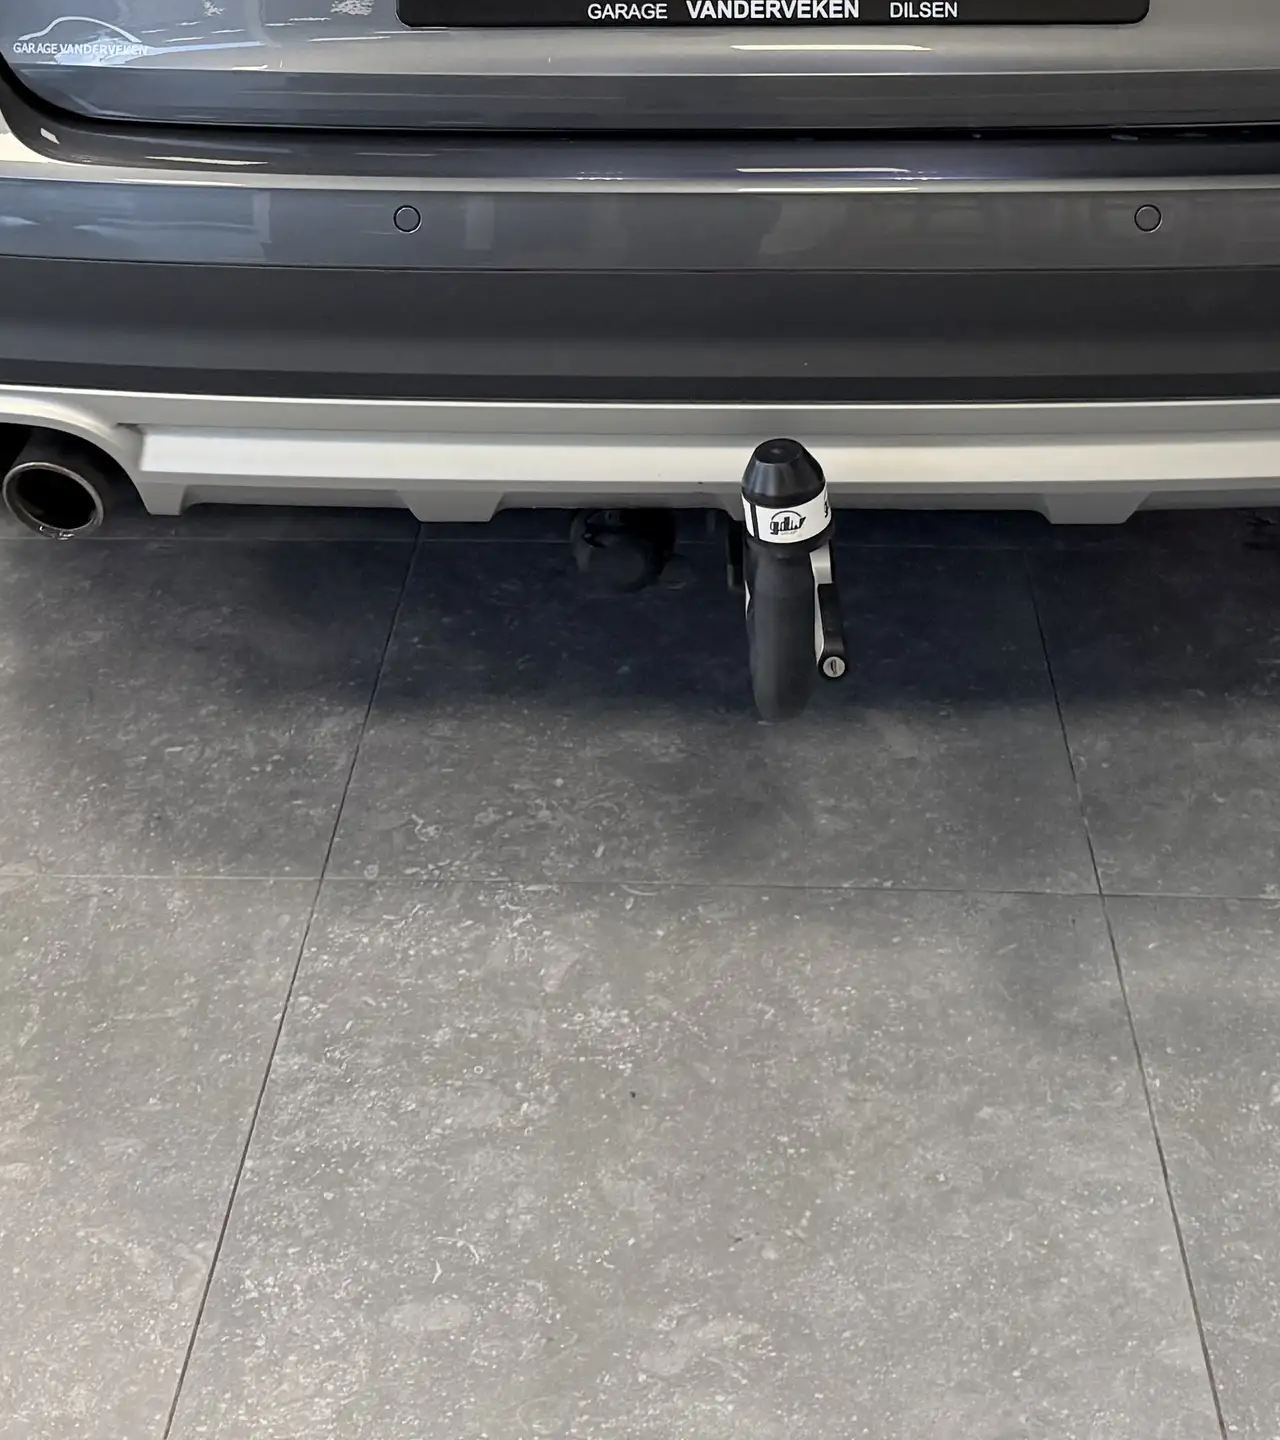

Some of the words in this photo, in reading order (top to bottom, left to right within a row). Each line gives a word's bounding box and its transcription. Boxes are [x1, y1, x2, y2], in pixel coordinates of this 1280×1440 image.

[587, 3, 668, 20] GARAGE
[686, 0, 859, 19] VANDERVEKEN
[890, 2, 958, 18] DILSEN
[13, 42, 57, 55] GARAGE
[60, 43, 148, 56] VANDERVEKEN
